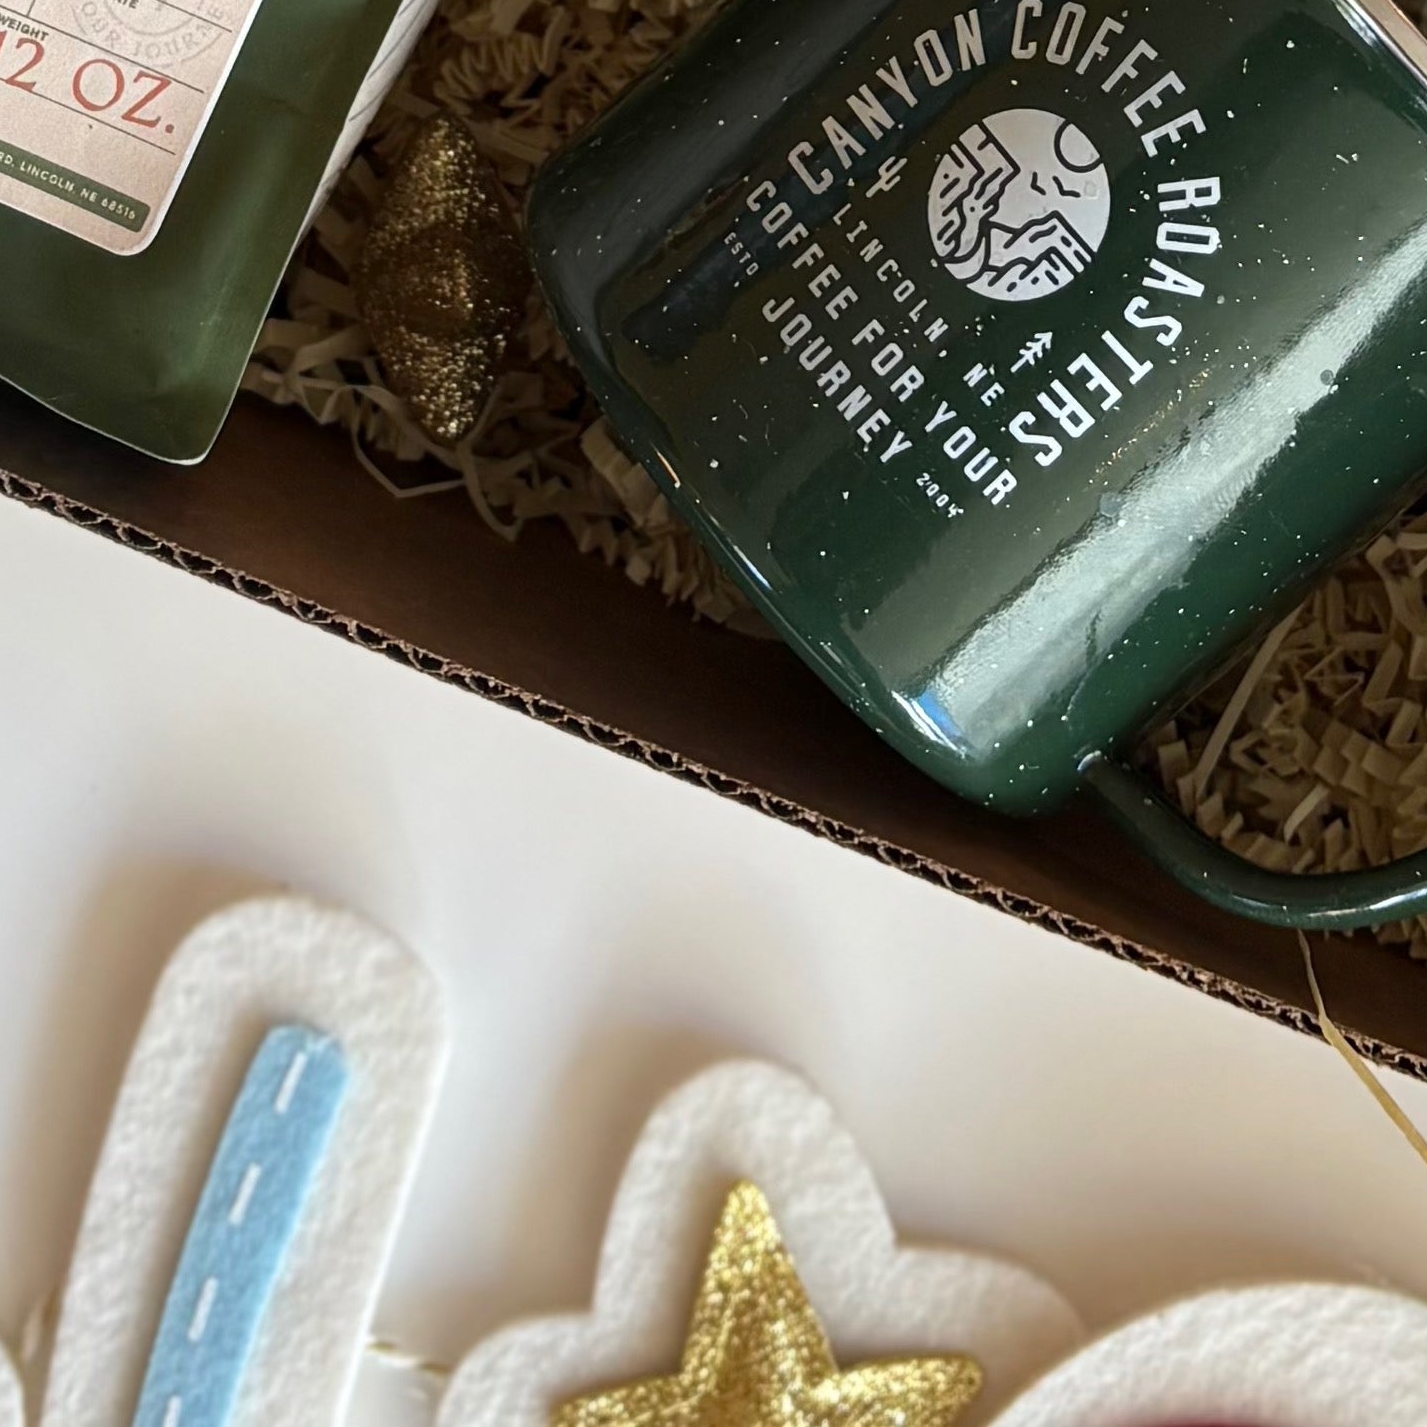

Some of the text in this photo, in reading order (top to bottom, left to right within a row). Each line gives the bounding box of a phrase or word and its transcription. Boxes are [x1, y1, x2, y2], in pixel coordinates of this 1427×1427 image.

[72, 58, 175, 134] OZ.
[80, 187, 98, 203] NE
[101, 195, 137, 221] 68516
[787, 8, 986, 195] CANYON
[1008, 175, 1222, 468] ROASTERS
[745, 180, 1018, 507] COFFEE FOR YOUR
[762, 296, 913, 465] JOURNEY
[963, 363, 1005, 406] NE
